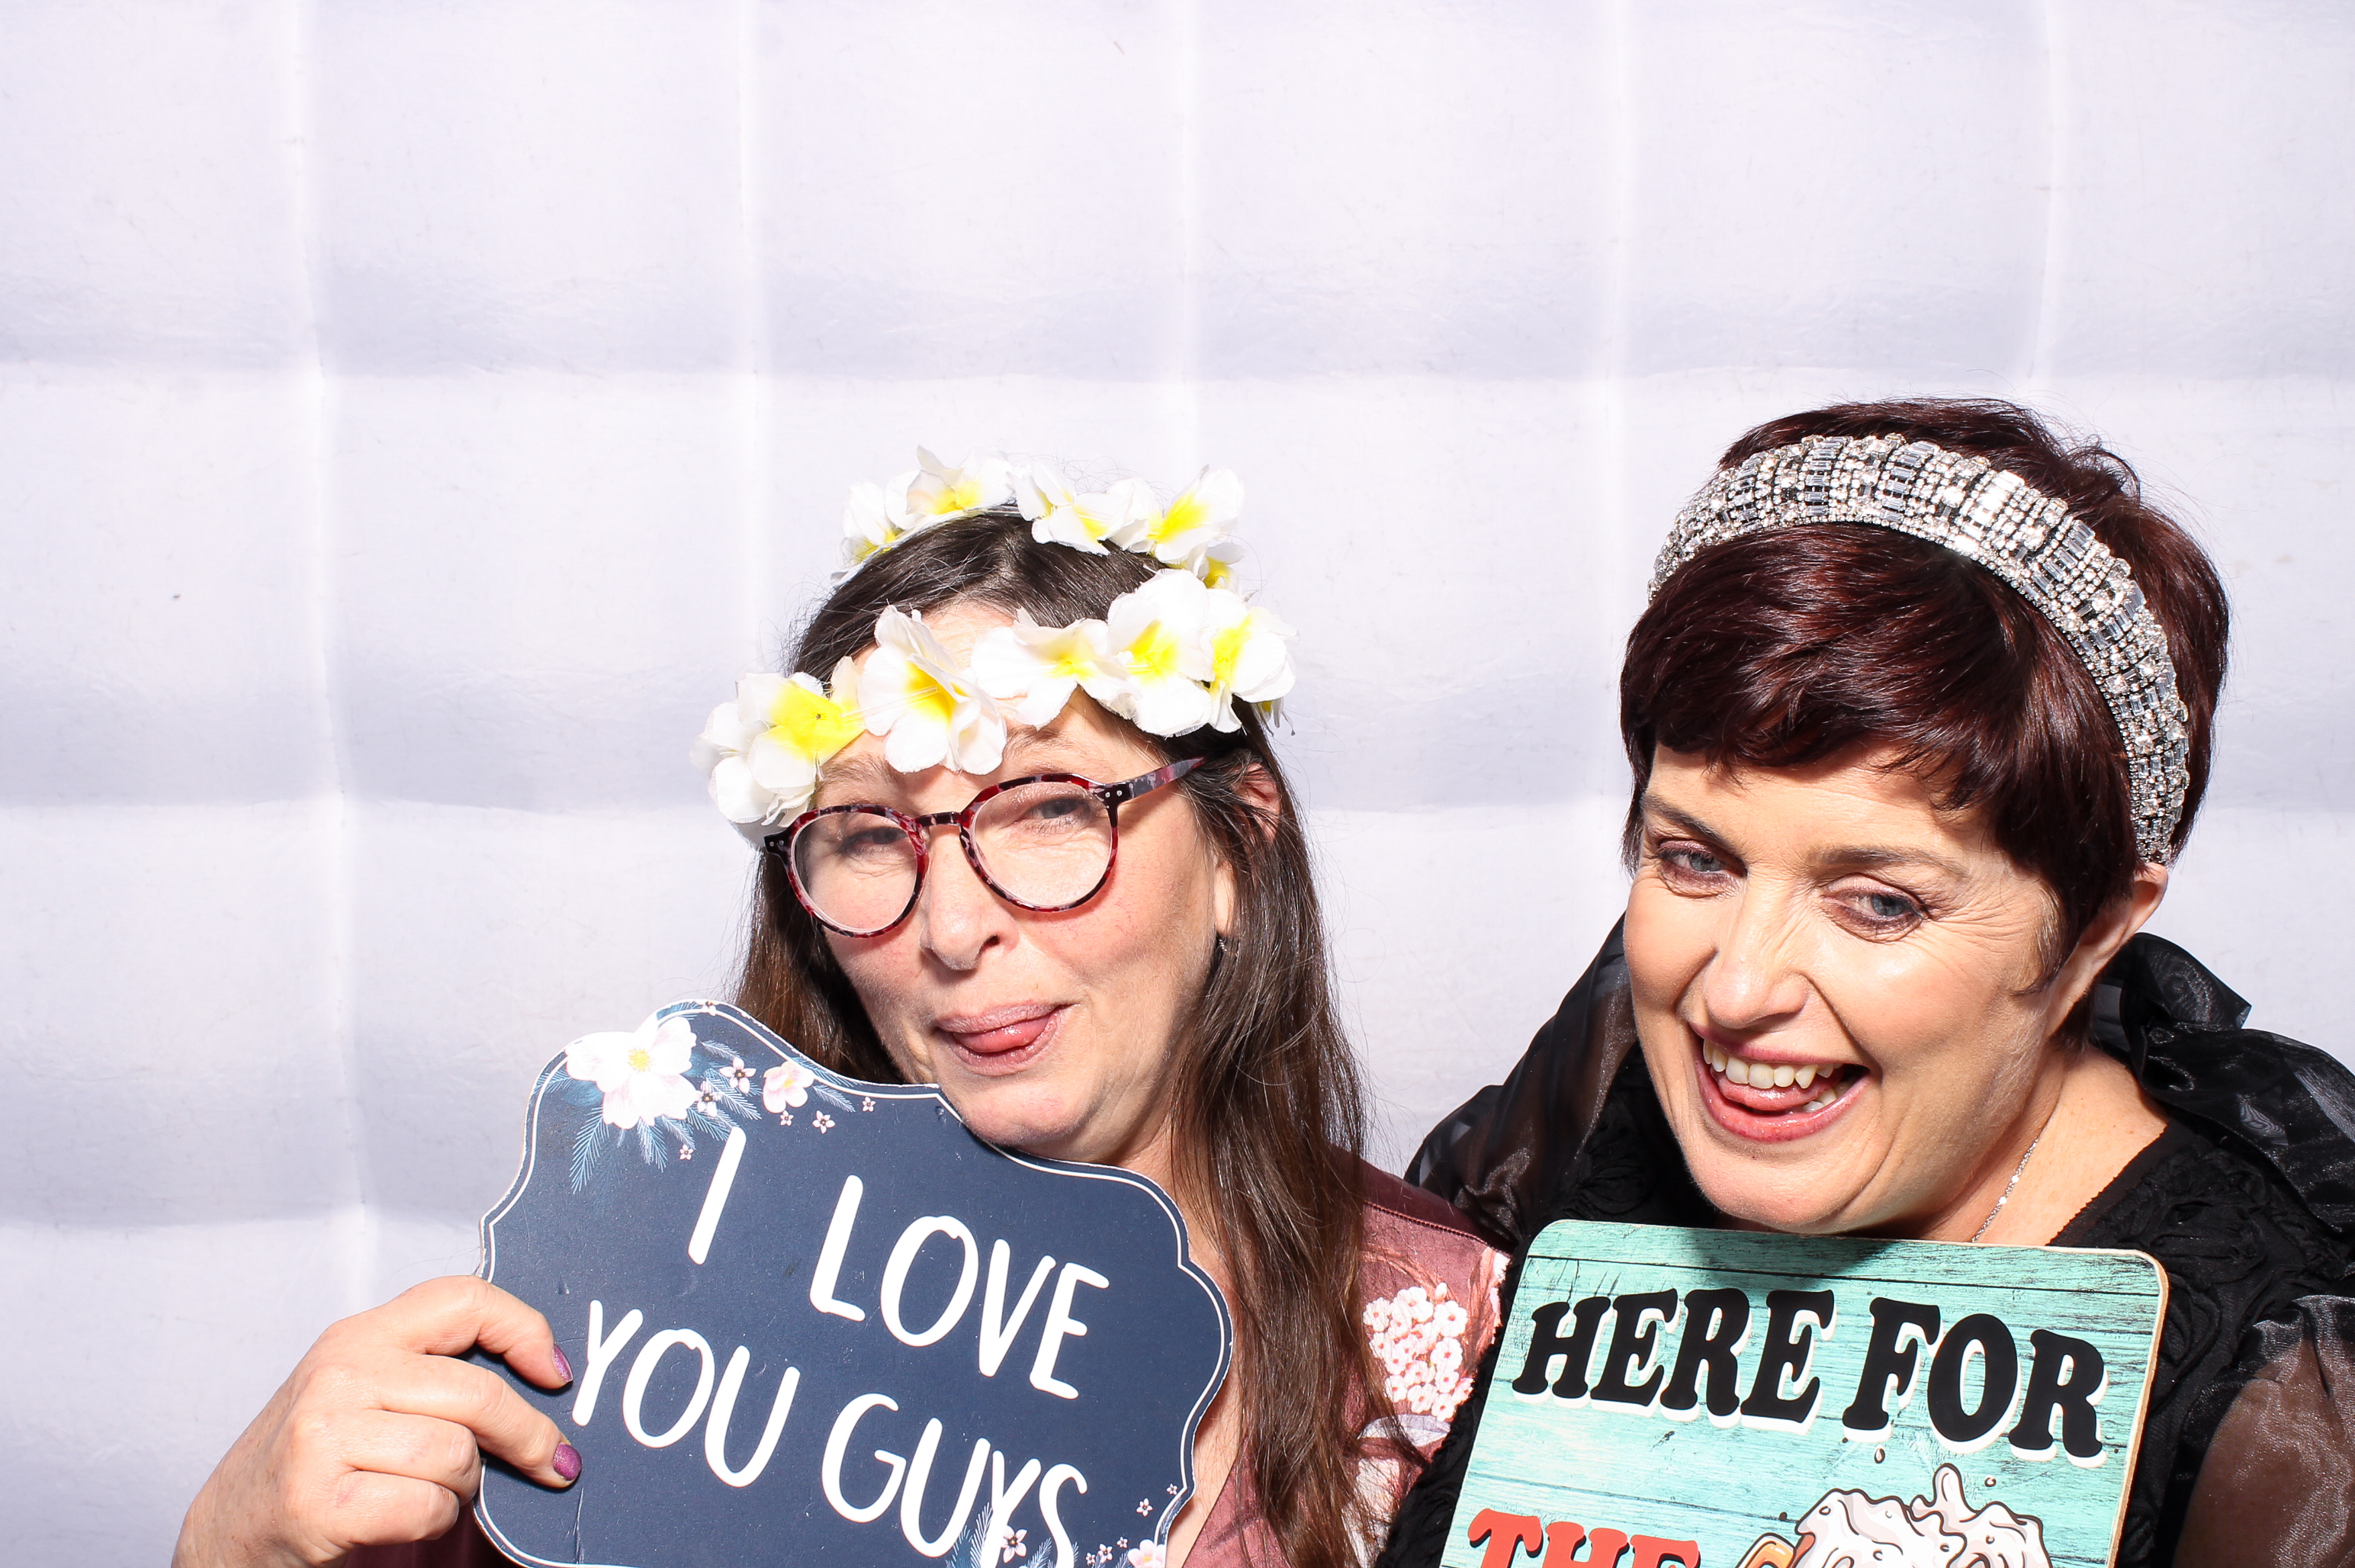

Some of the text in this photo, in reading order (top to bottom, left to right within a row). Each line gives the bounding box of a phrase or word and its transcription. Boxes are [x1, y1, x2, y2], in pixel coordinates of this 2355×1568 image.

[687, 1126, 1110, 1399] I LOVE
[1512, 1287, 2107, 1462] HERE FOR
[571, 1300, 1088, 1568] YOU GUYS
